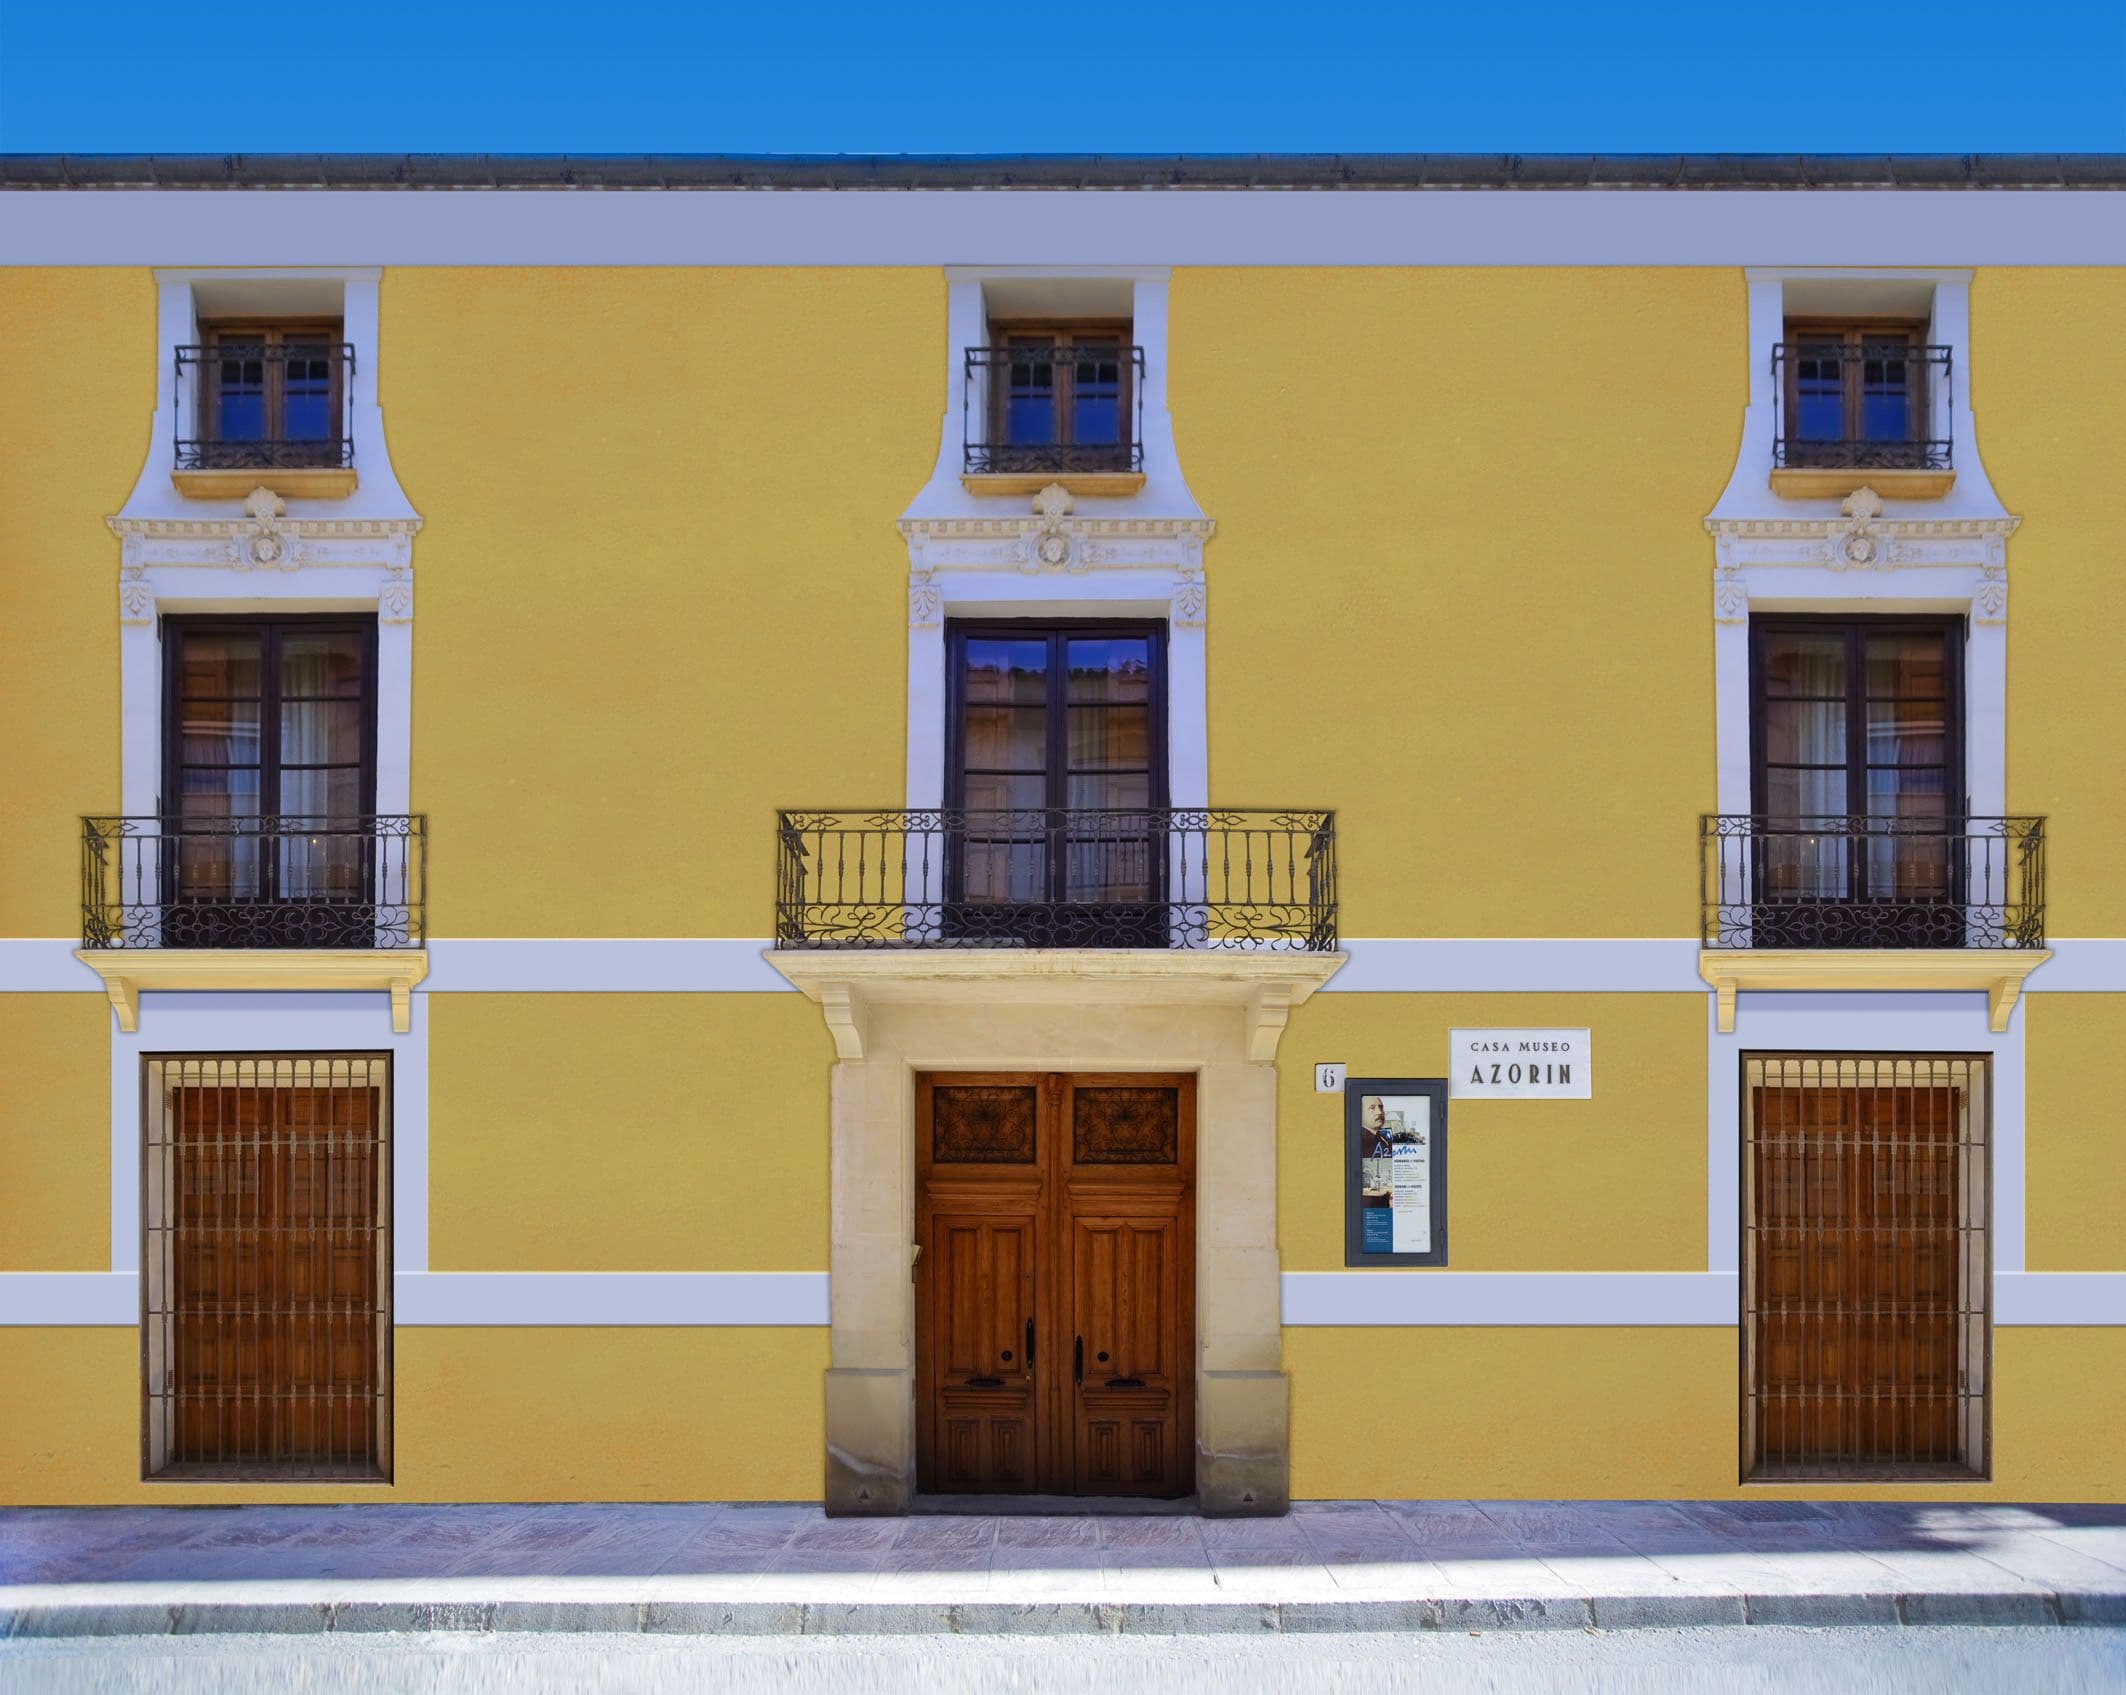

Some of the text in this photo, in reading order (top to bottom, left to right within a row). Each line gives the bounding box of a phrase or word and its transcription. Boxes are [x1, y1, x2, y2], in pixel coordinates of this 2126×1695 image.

[1470, 1042, 1570, 1052] CASA MUSEO
[1322, 1068, 1335, 1088] 6
[1470, 1063, 1571, 1084] AZORIN
